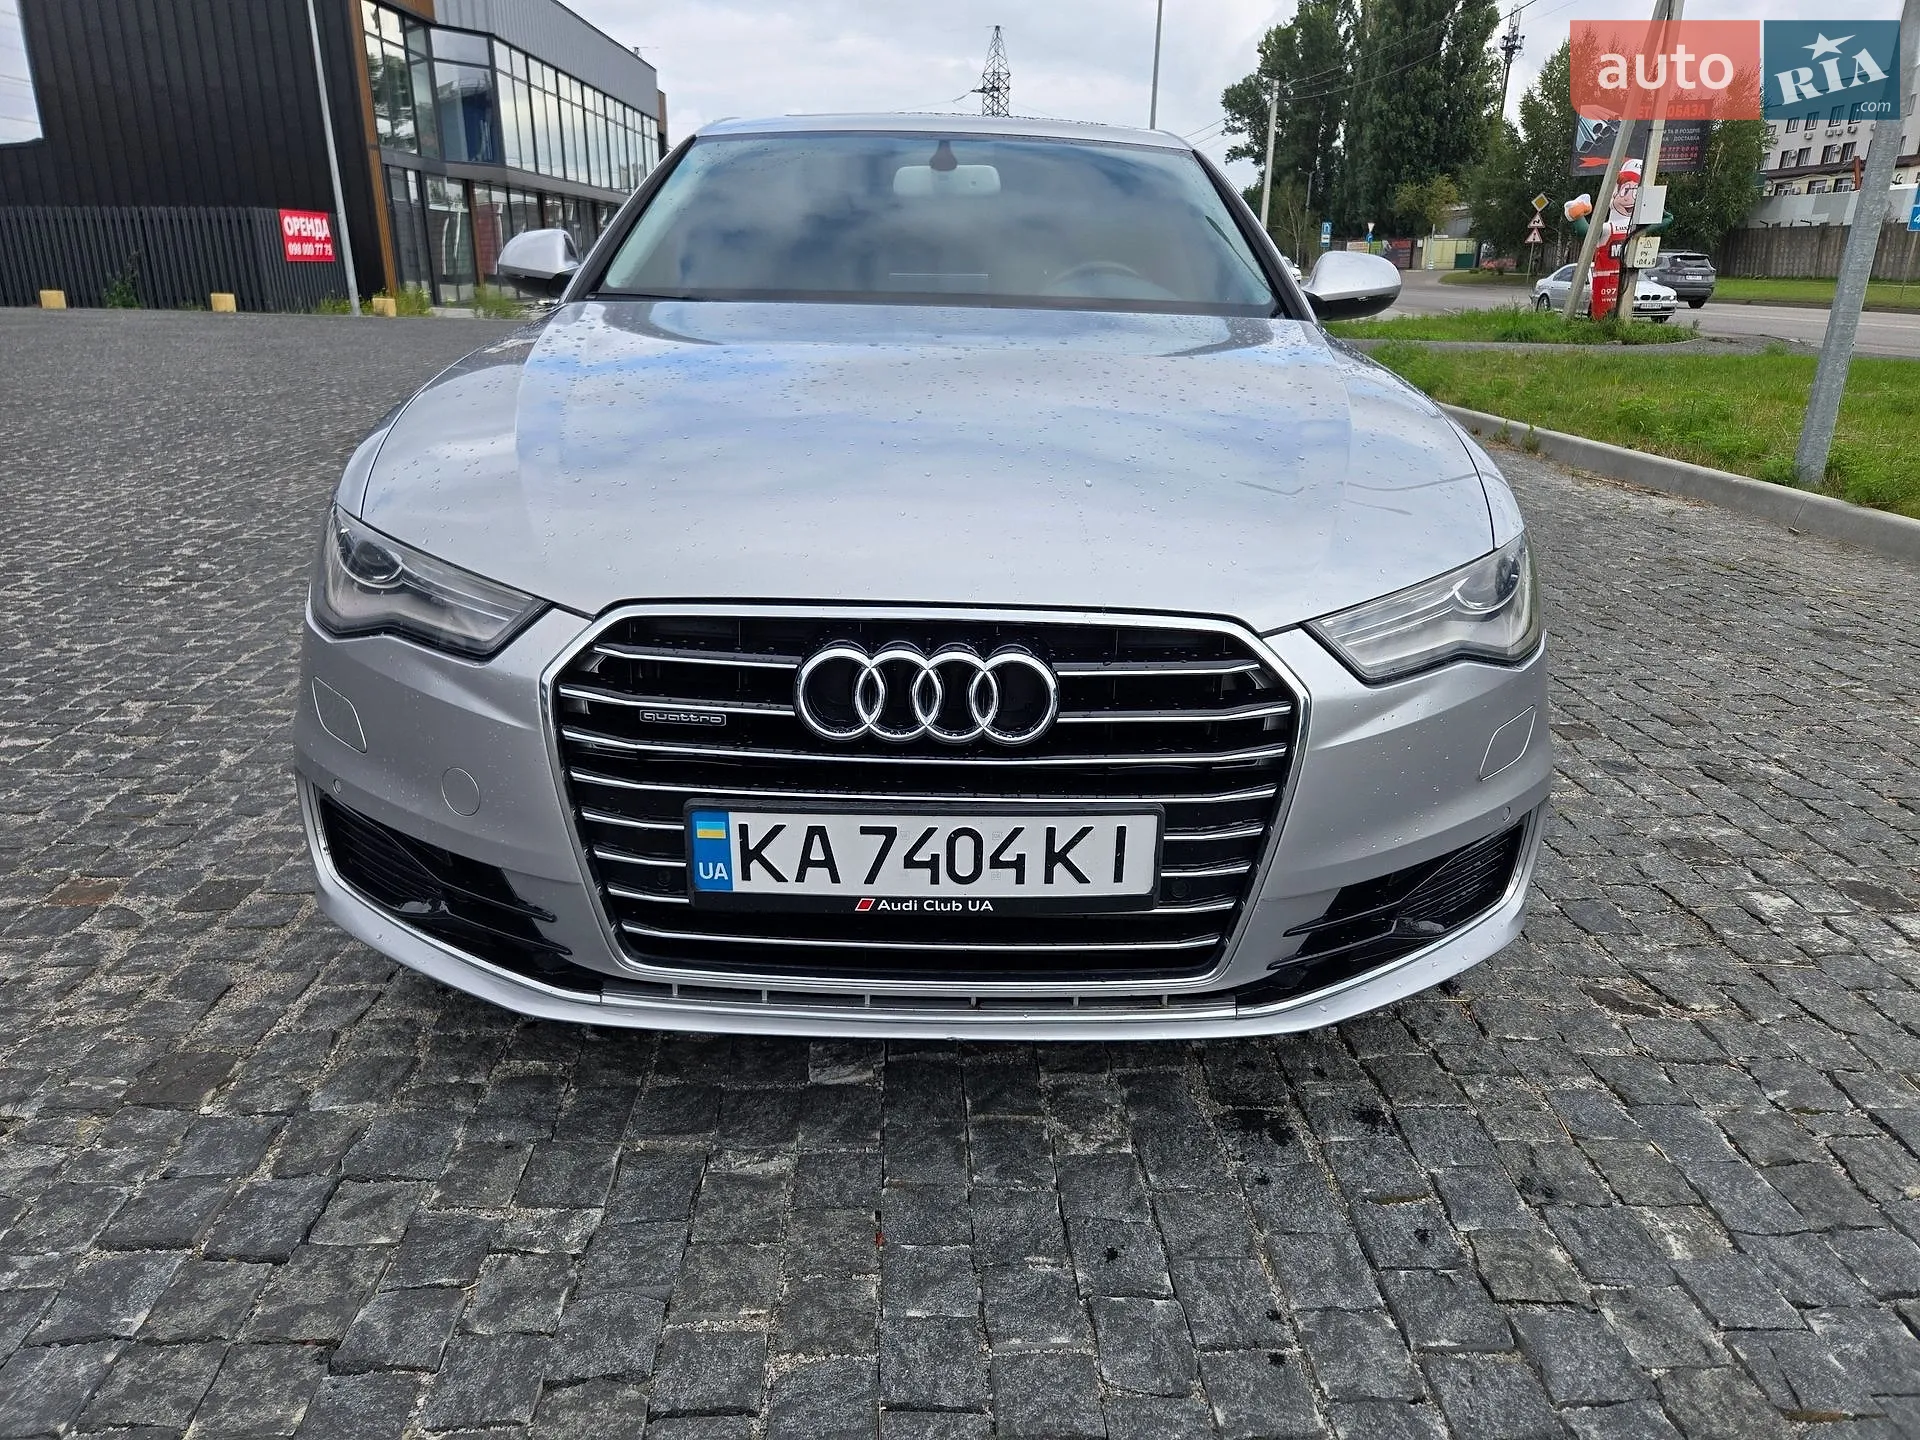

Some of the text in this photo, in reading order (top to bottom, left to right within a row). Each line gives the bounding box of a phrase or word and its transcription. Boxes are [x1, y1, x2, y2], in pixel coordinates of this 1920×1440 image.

[283, 216, 331, 241] ОРЕНДА
[643, 712, 722, 723] quattro
[698, 861, 728, 881] UA
[877, 899, 994, 911] Audi Club UA
